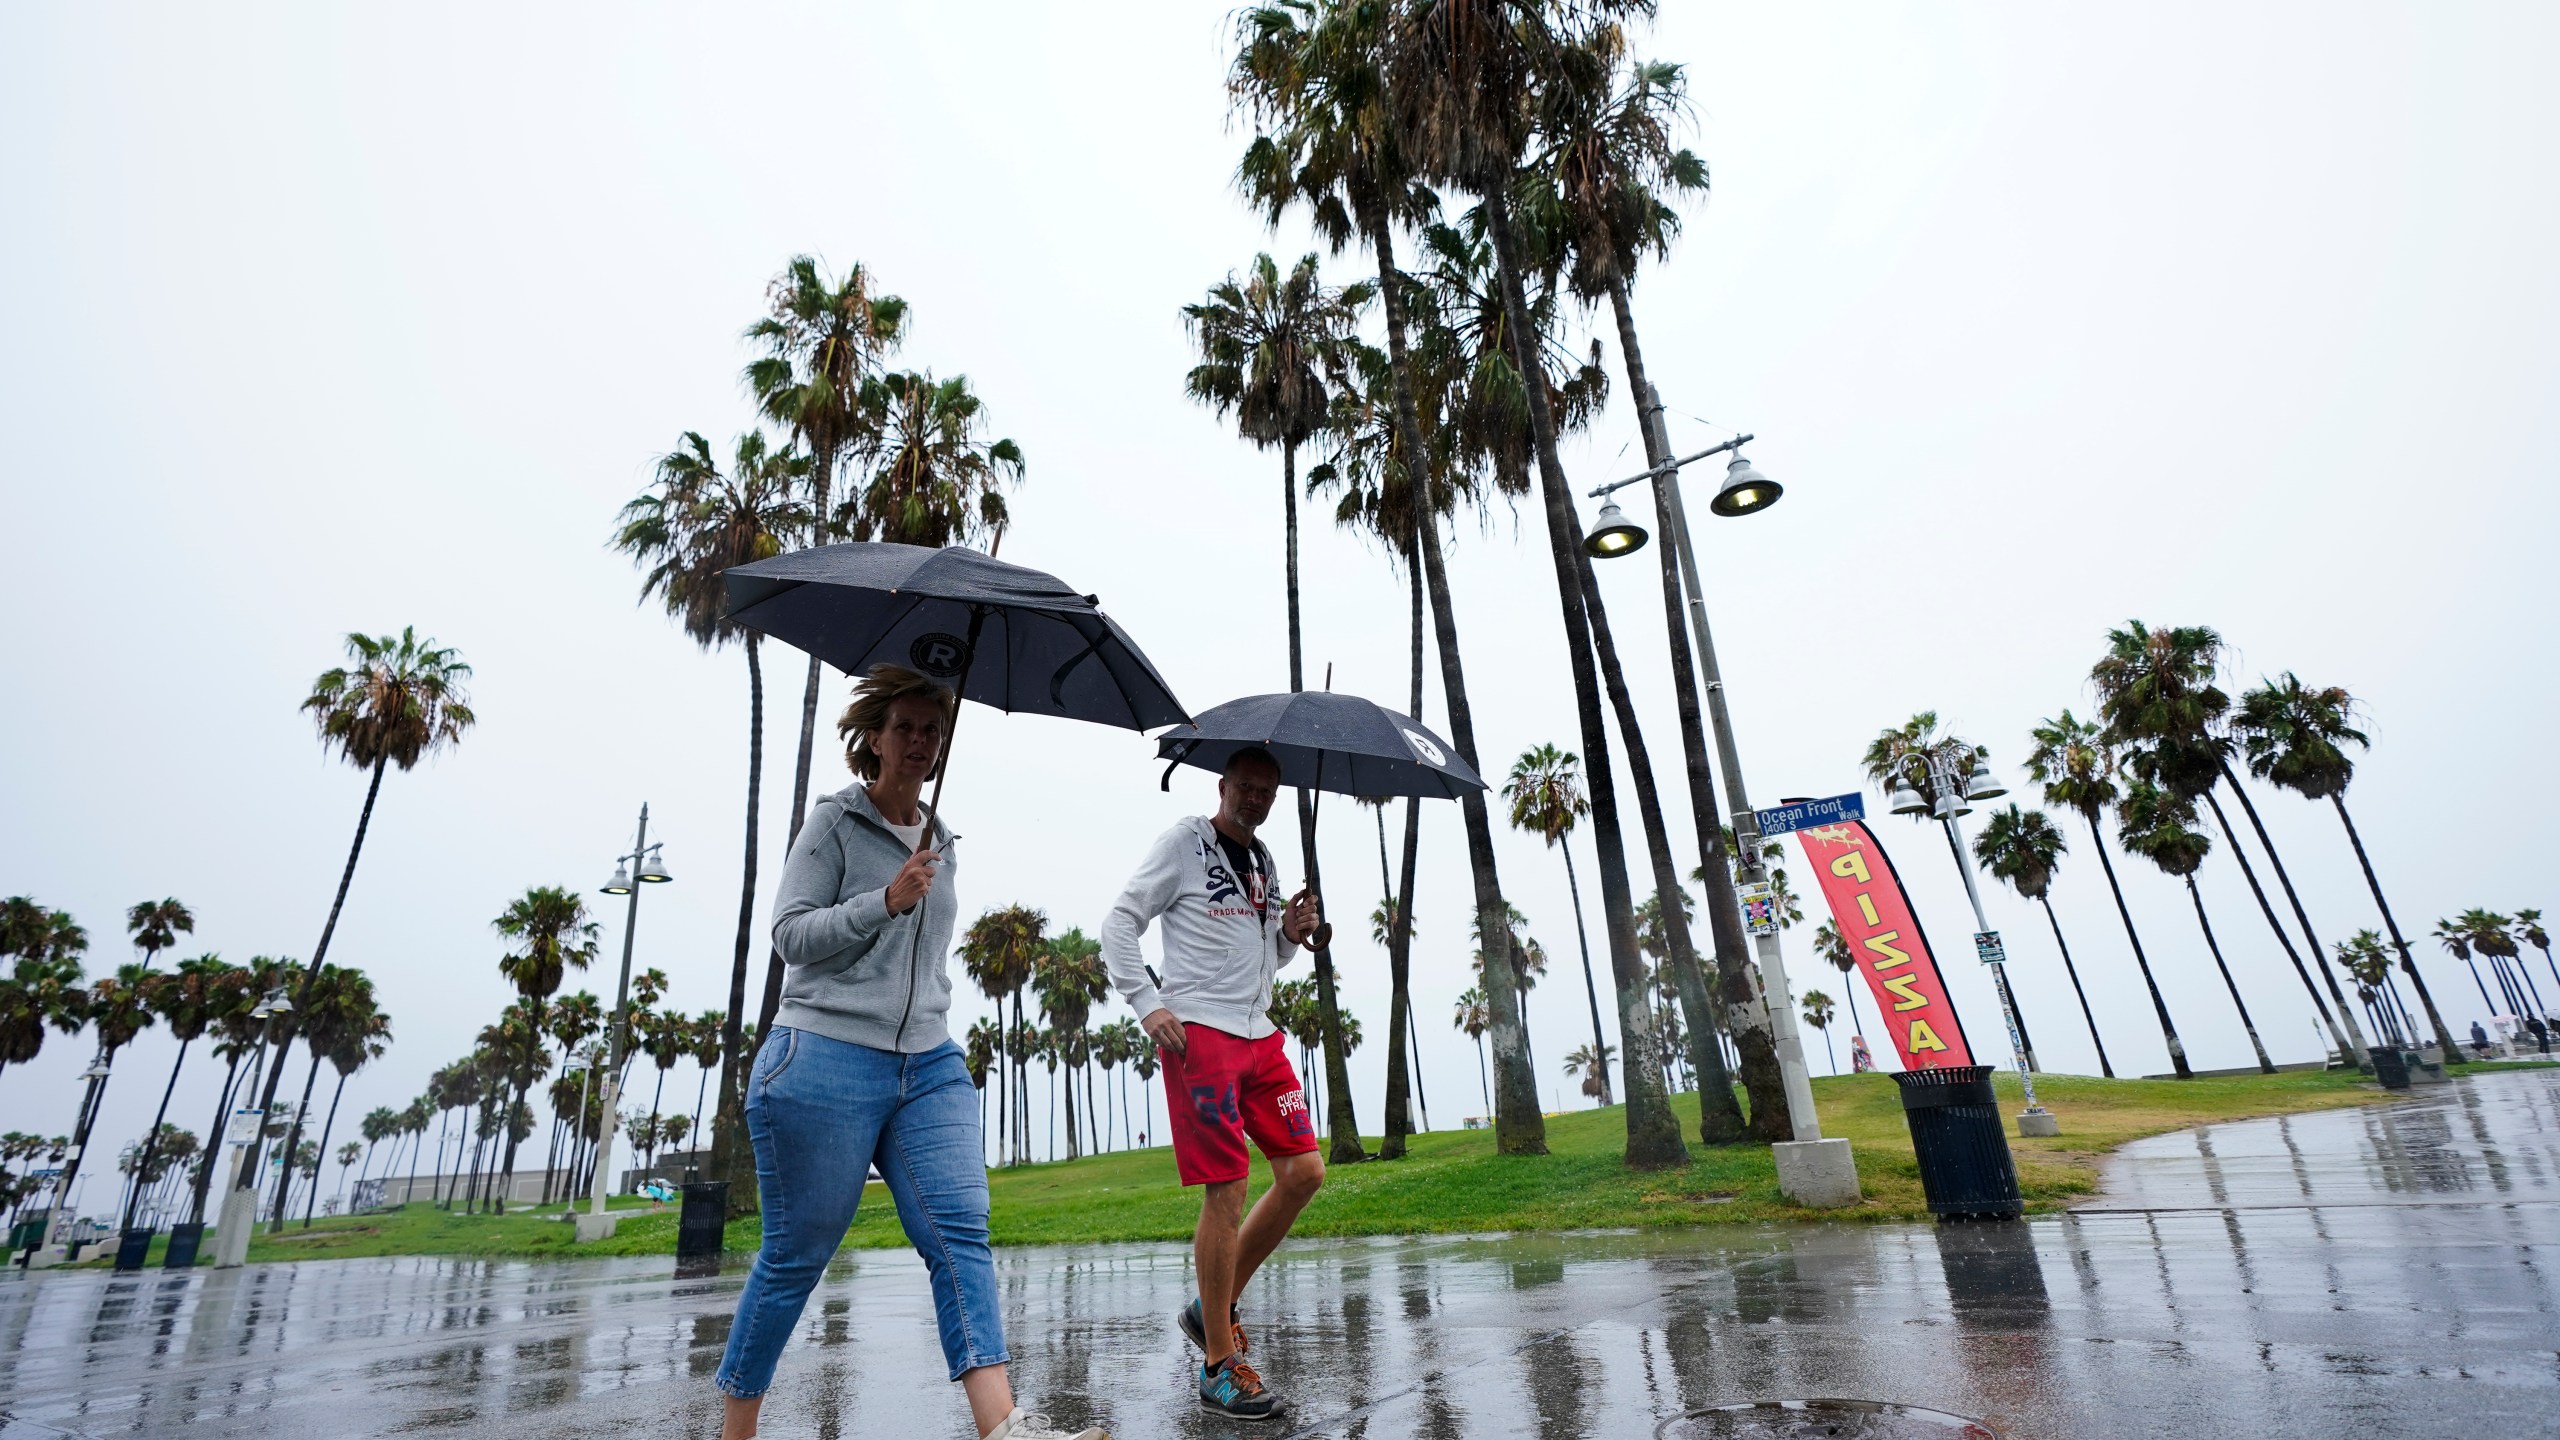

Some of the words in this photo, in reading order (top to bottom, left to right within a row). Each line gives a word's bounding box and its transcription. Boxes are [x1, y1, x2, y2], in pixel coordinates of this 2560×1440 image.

[927, 642, 956, 668] R
[1414, 738, 1436, 756] R
[1761, 809, 1803, 826] Ocean
[1807, 798, 1844, 817] Front
[1838, 809, 1860, 821] Walk
[1764, 822, 1786, 836] 1400
[1790, 820, 1797, 830] S
[1208, 908, 1236, 917] TRADE
[1215, 1381, 1240, 1406] N
